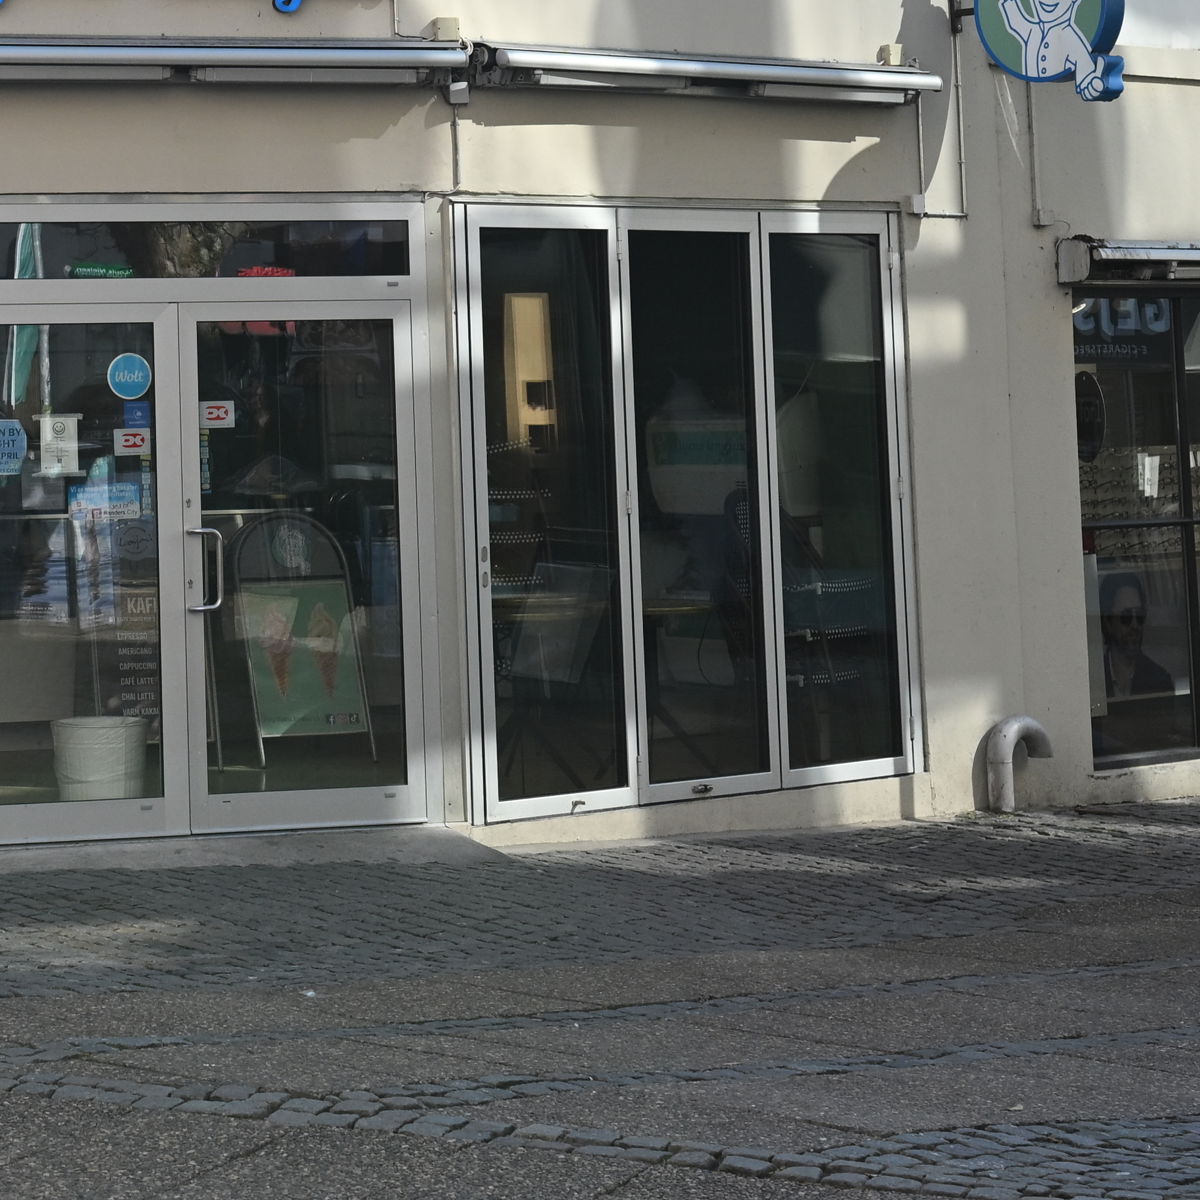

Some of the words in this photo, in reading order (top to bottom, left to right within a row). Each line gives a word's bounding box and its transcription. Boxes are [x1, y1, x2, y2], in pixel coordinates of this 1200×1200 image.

[115, 370, 144, 382] Wolt
[8, 428, 22, 437] BY
[118, 647, 152, 656] AMERICANO
[119, 662, 157, 671] CAPPUCCINO
[136, 677, 154, 685] LATTE
[121, 692, 136, 701] CHAI
[137, 691, 155, 700] LATTE
